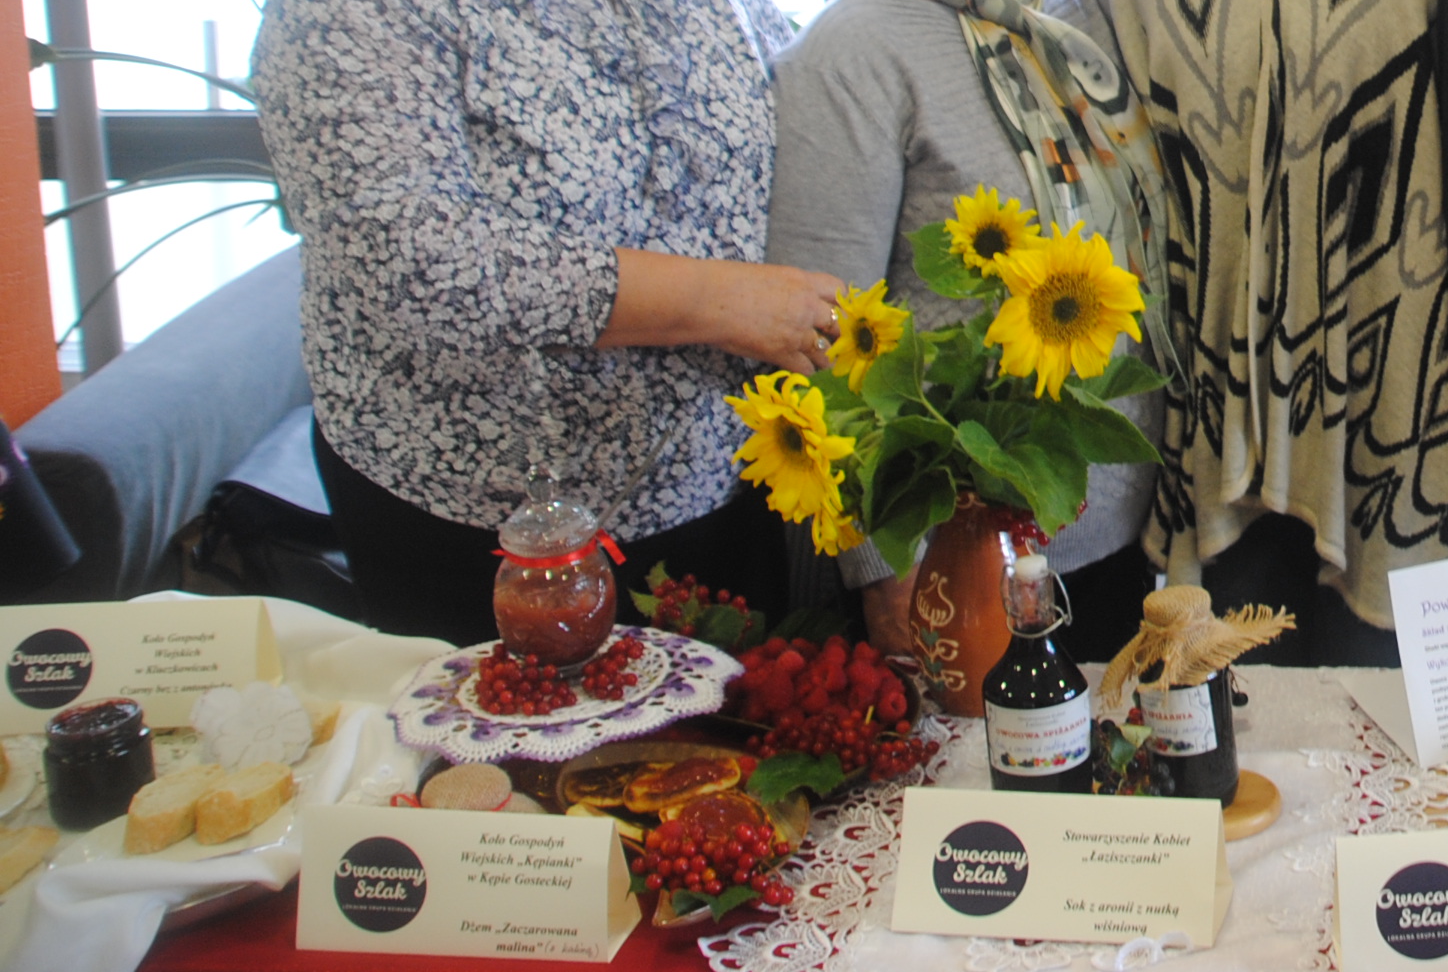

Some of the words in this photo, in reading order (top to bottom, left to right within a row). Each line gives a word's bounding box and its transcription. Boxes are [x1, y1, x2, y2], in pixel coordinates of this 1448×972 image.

[8, 650, 92, 669] Owocowy
[24, 665, 75, 683] Szlak
[479, 833, 506, 845] Koło
[508, 834, 565, 849] Gospodyń
[1062, 830, 1151, 846] Stowarzyszenie
[1153, 831, 1191, 847] Kobiet
[460, 851, 515, 867] Wiejskich
[935, 842, 1029, 871] Owocowy
[335, 857, 427, 887] Owocowy
[467, 874, 477, 883] w
[479, 871, 512, 886] Kępie
[514, 873, 573, 890] Gosteckiej
[953, 863, 1008, 885] Szlak
[354, 880, 408, 901] Szlak
[1063, 898, 1086, 912] Sok
[1089, 902, 1096, 912] z
[1098, 899, 1136, 914] aronii
[1137, 903, 1143, 914] z
[1145, 900, 1180, 918] nutką
[460, 920, 493, 934] Dżem
[1093, 919, 1148, 935] wiśniową
